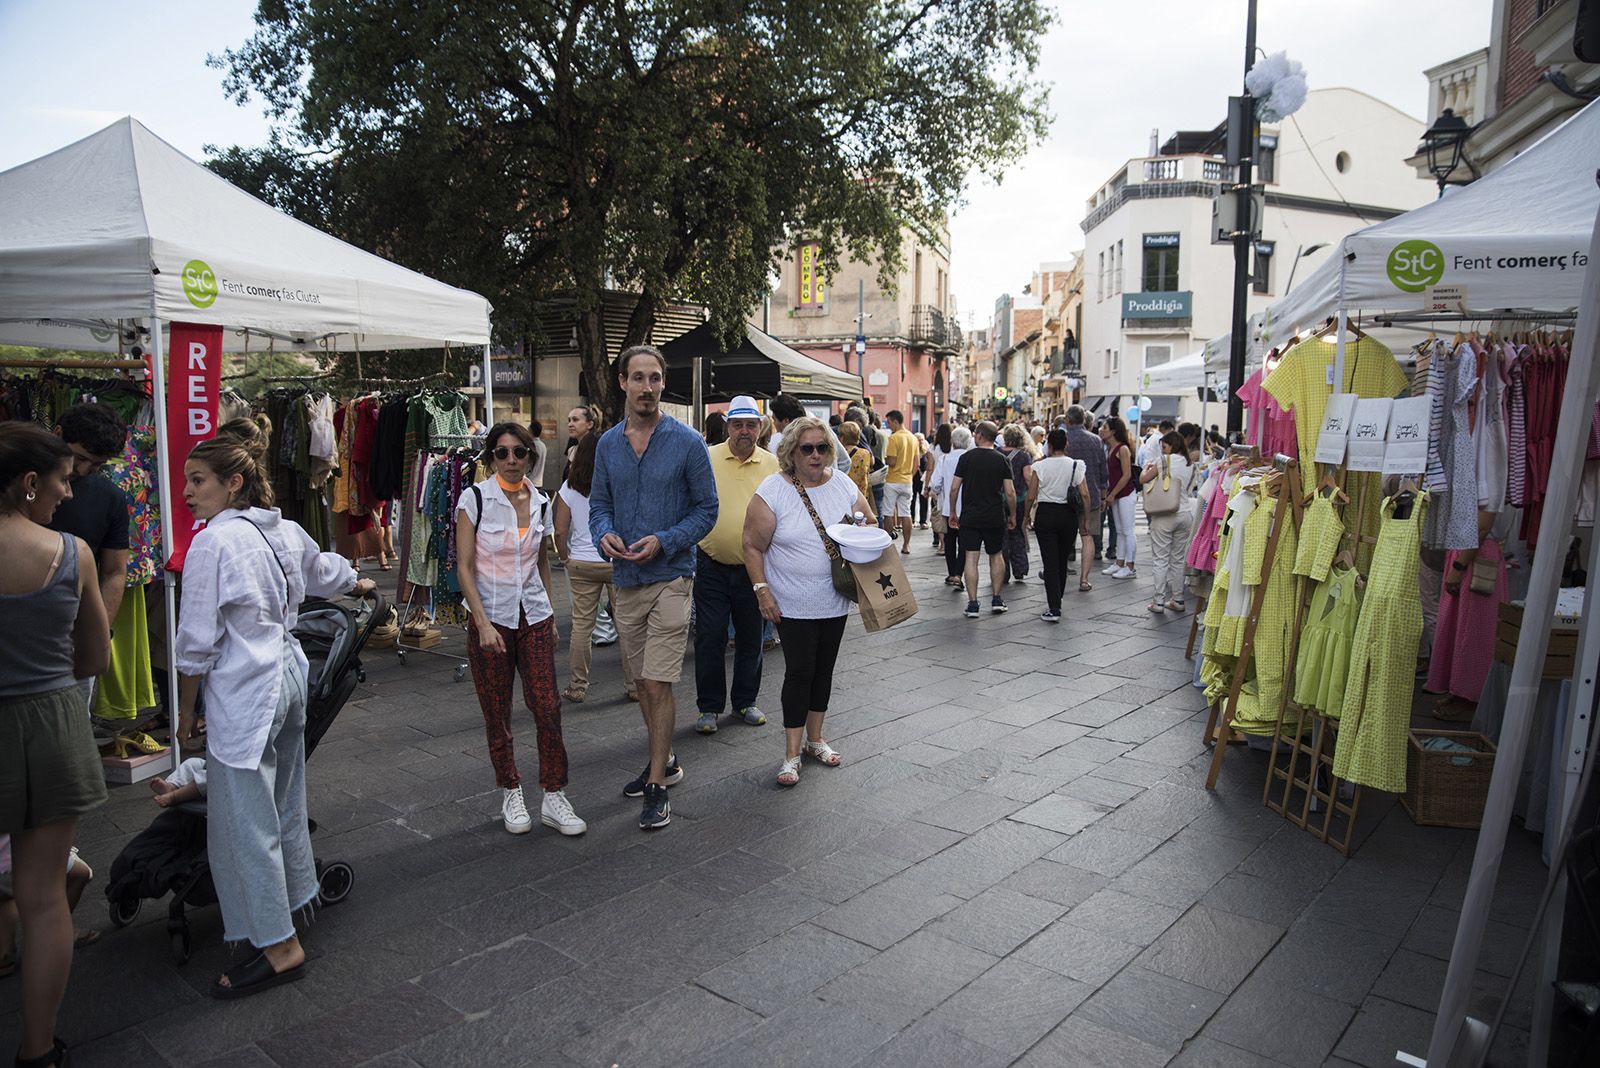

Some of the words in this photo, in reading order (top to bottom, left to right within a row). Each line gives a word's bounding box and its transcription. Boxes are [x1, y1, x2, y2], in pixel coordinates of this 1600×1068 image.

[1145, 236, 1178, 244] Proddigia
[1454, 255, 1493, 270] Fent
[1497, 253, 1567, 271] comerç
[222, 279, 245, 294] Fent
[246, 285, 281, 302] comerç
[282, 287, 295, 300] fas
[295, 289, 321, 304] Ciutat
[1128, 299, 1183, 313] Proddigia
[883, 588, 899, 600] KIDS
